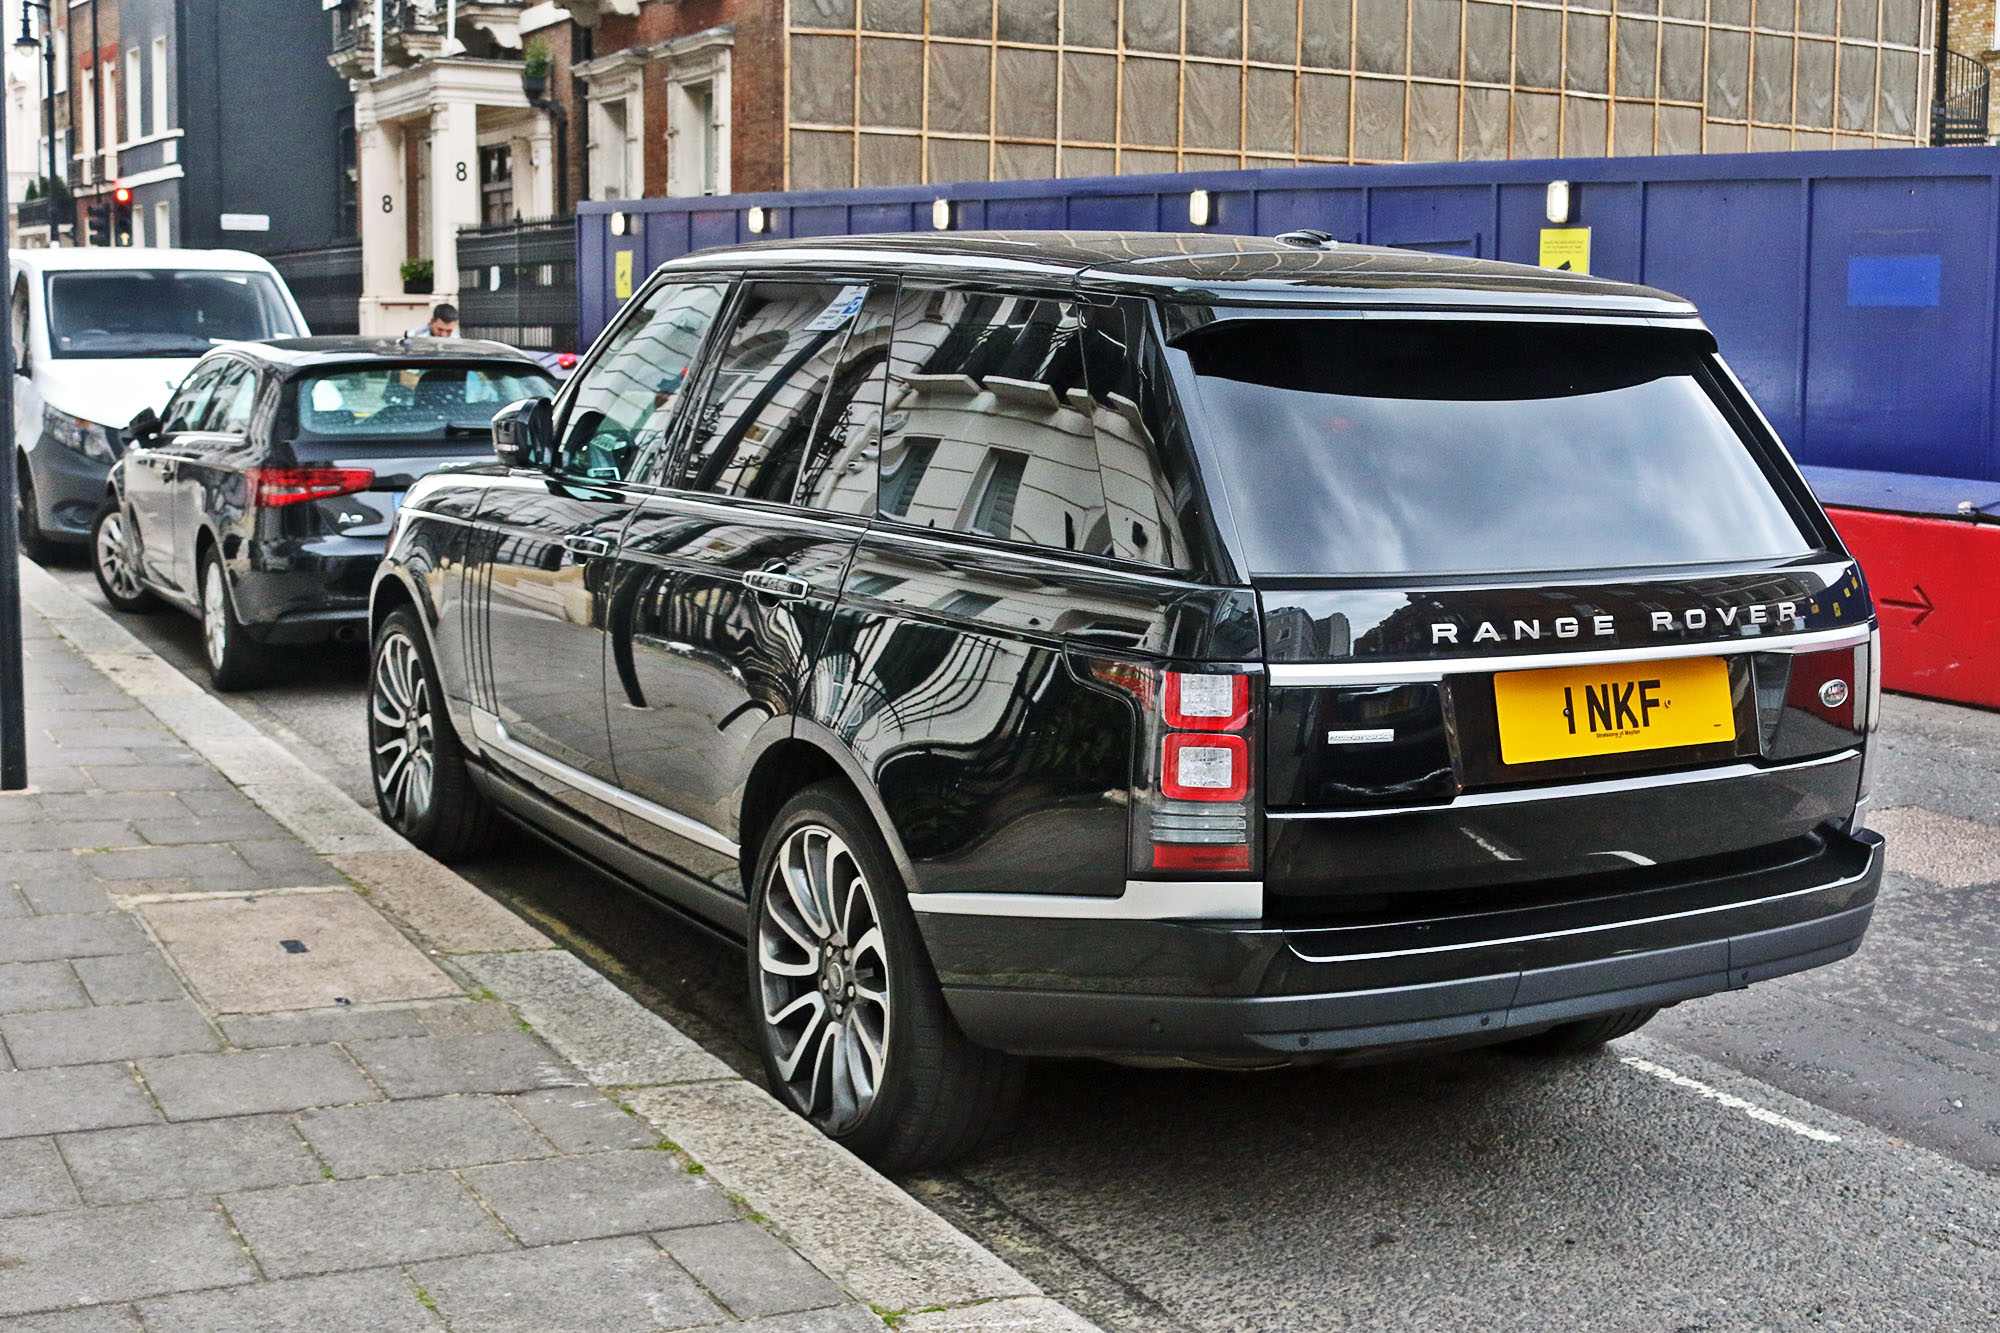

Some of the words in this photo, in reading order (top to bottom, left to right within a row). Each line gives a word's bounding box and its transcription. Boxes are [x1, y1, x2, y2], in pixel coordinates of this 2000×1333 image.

[456, 161, 467, 181] 8
[382, 194, 393, 213] 8
[1431, 615, 1615, 644] RANGE
[1651, 602, 1798, 632] ROVER
